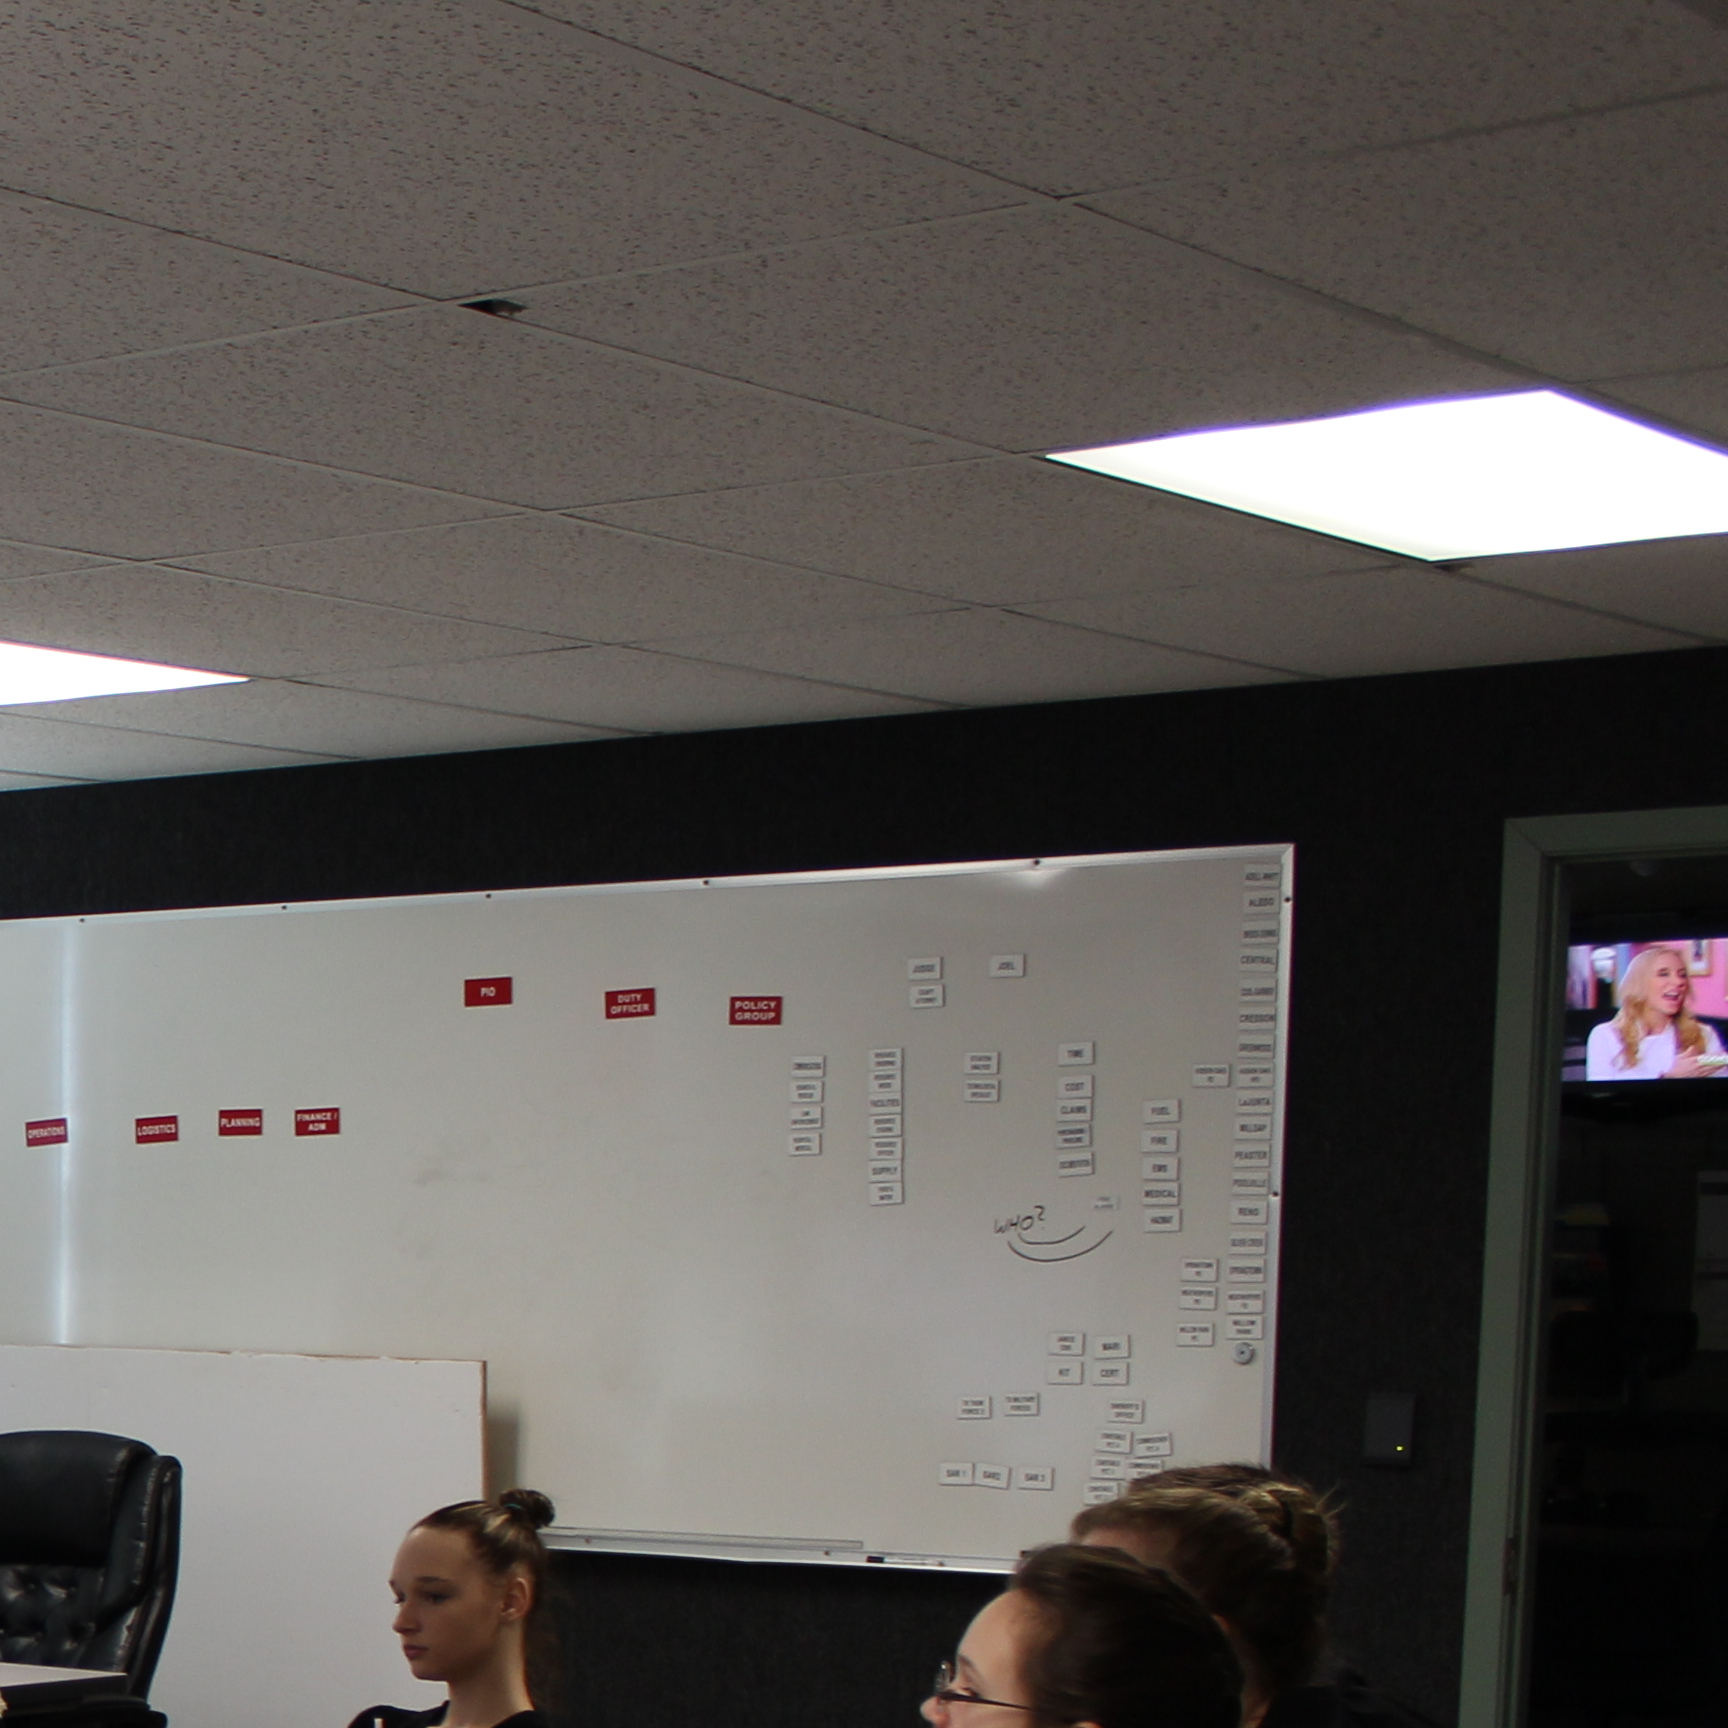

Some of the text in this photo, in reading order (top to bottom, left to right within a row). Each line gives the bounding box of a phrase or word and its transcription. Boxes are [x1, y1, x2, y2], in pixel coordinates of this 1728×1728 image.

[480, 986, 497, 998] PIO
[616, 993, 642, 1004] DUTY
[610, 1004, 650, 1015] OFFICER
[734, 1000, 778, 1010] POLICY
[734, 1011, 776, 1021] GROUP
[220, 1116, 261, 1128] PLANNING
[296, 1111, 331, 1123] FINANCE
[27, 1124, 66, 1139] OPERATIONS
[136, 1123, 177, 1137] LOGISTICS
[307, 1122, 327, 1133] ADM
[994, 1204, 1046, 1234] WHO?
